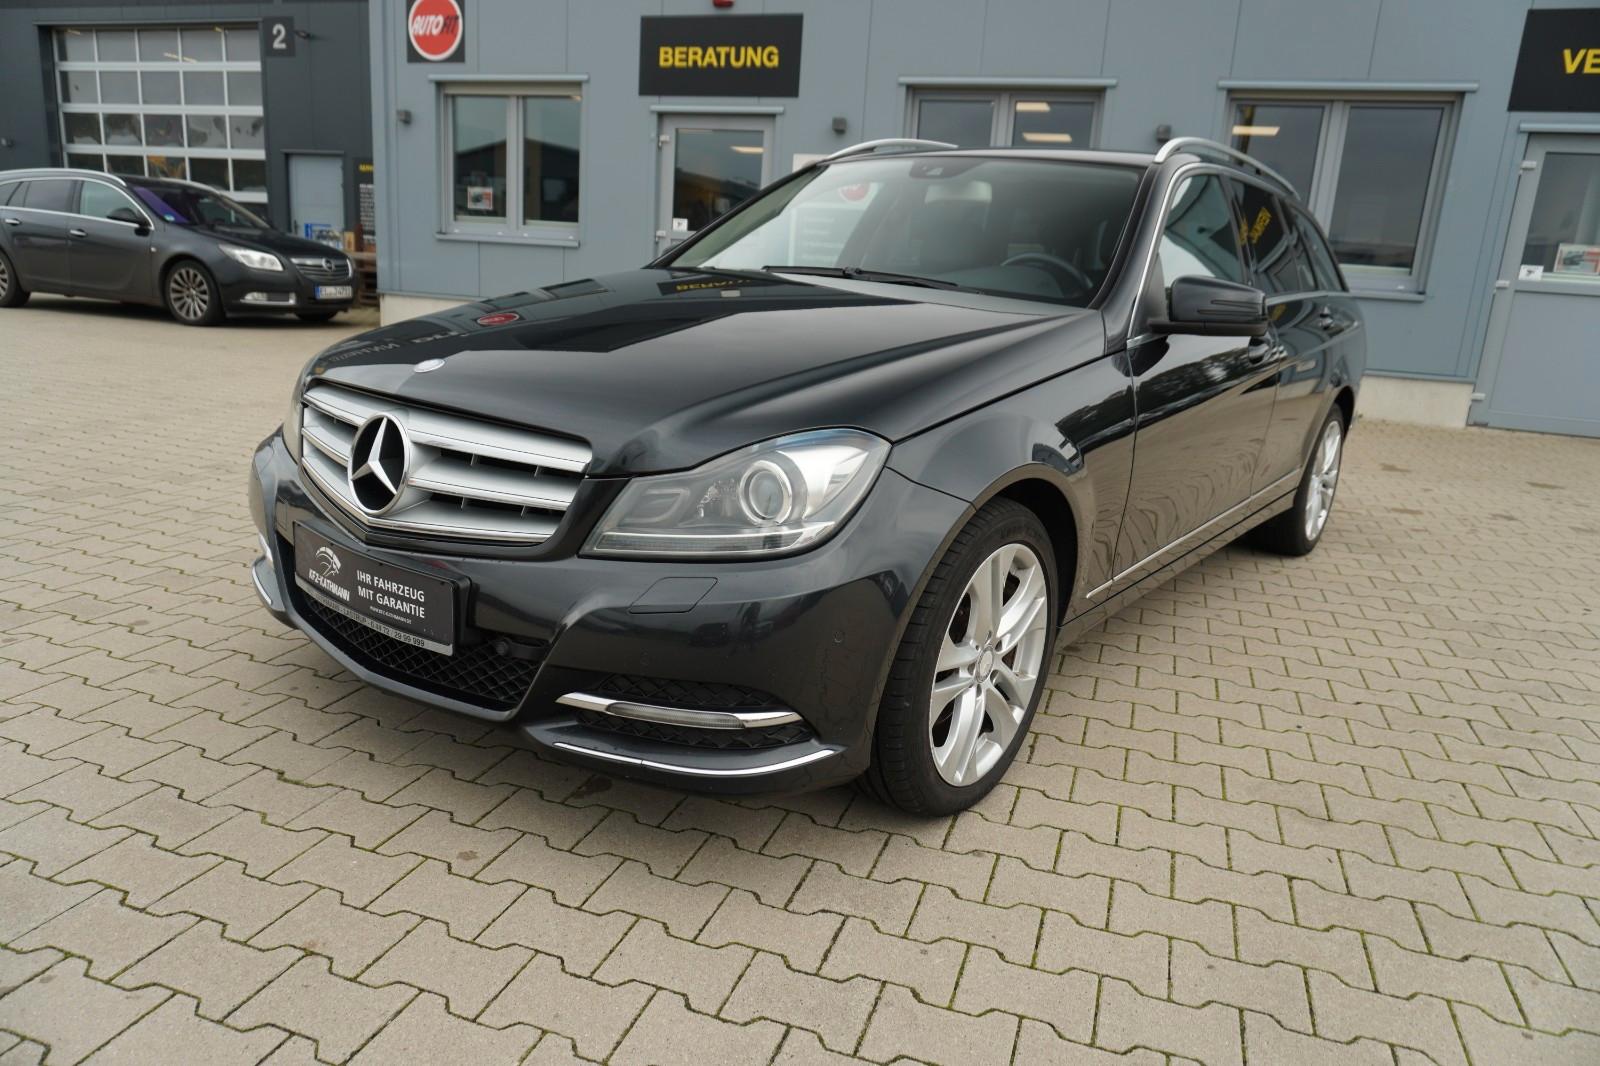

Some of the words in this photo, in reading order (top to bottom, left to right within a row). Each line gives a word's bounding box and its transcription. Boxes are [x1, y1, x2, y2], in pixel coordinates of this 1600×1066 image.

[272, 23, 286, 49] 2
[659, 45, 779, 68] BERATUNG
[357, 570, 372, 585] IHR
[374, 576, 425, 602] FAHRZEUG
[358, 585, 374, 600] MIT
[376, 593, 425, 619] GARANTIE
